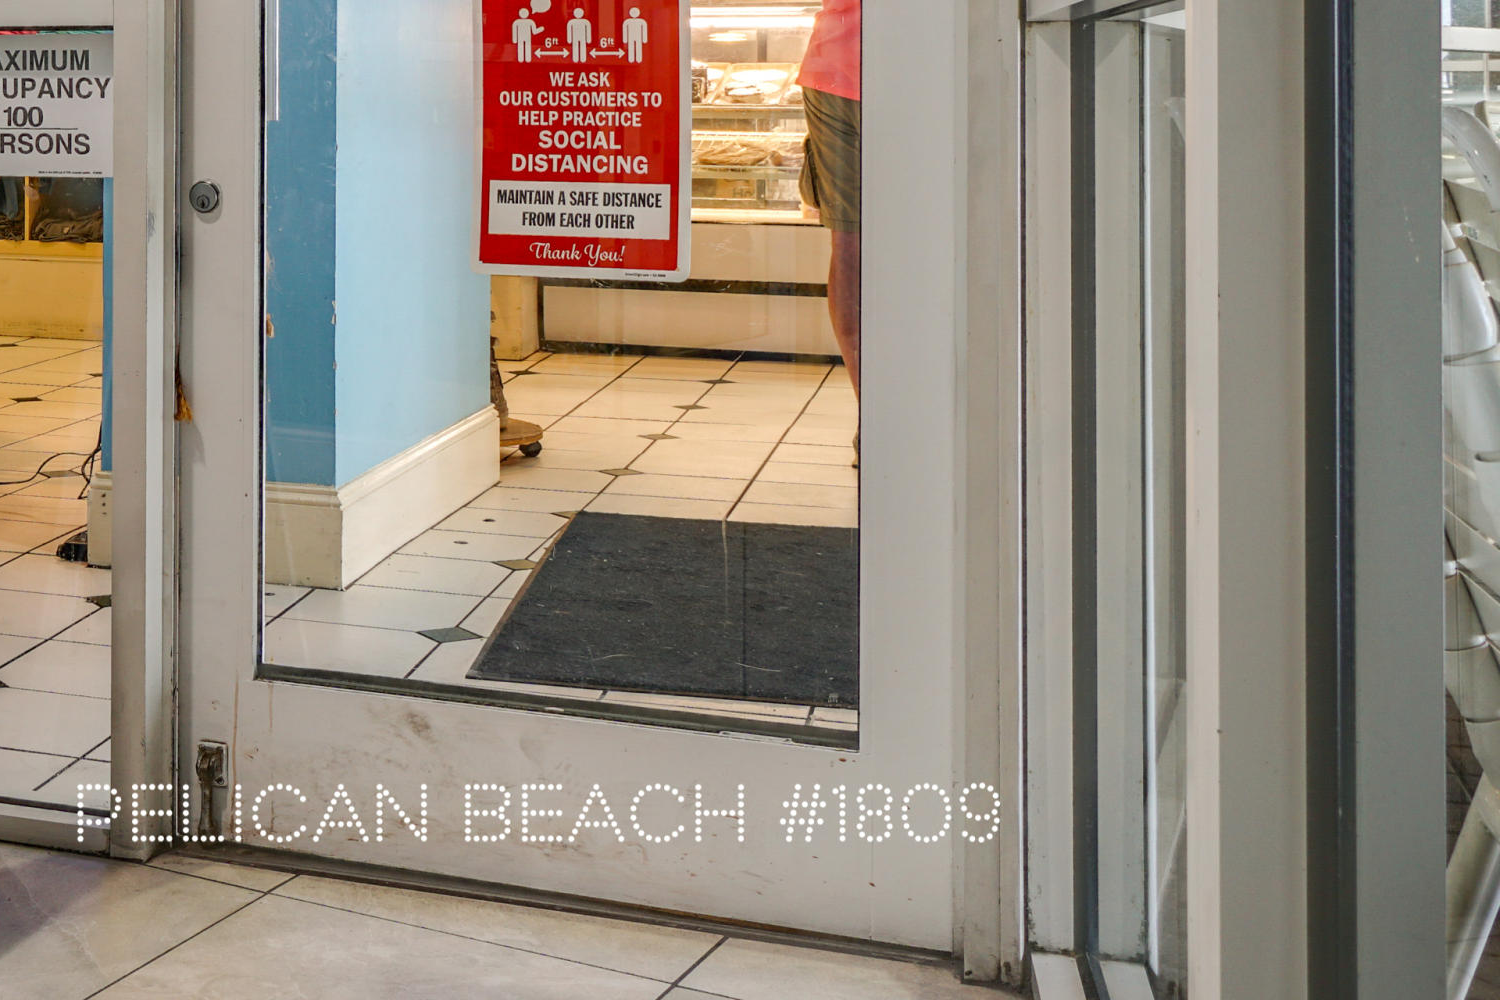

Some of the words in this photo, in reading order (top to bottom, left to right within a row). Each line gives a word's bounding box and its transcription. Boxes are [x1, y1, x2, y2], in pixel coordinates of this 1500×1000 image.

[544, 37, 559, 49] 6ft
[600, 37, 615, 49] 6ft
[549, 72, 575, 87] WE
[577, 72, 611, 87] ASK
[500, 91, 533, 106] OUR
[537, 91, 638, 107] CUSTOMERS
[641, 92, 662, 107] TO
[3, 106, 44, 127] 100
[518, 110, 559, 126] HELP
[562, 111, 642, 127] PRACTICE
[538, 130, 621, 150] SOCIAL
[511, 153, 649, 175] DISTANCING
[497, 189, 555, 205] MAINTAIN
[558, 191, 566, 206] A
[569, 190, 599, 207] SAFE
[603, 192, 662, 208] DISTANCE
[522, 211, 556, 227] FROM
[559, 213, 591, 228] EACH
[595, 213, 635, 230] OTHER
[529, 242, 582, 261] Thank
[584, 244, 626, 266] You!
